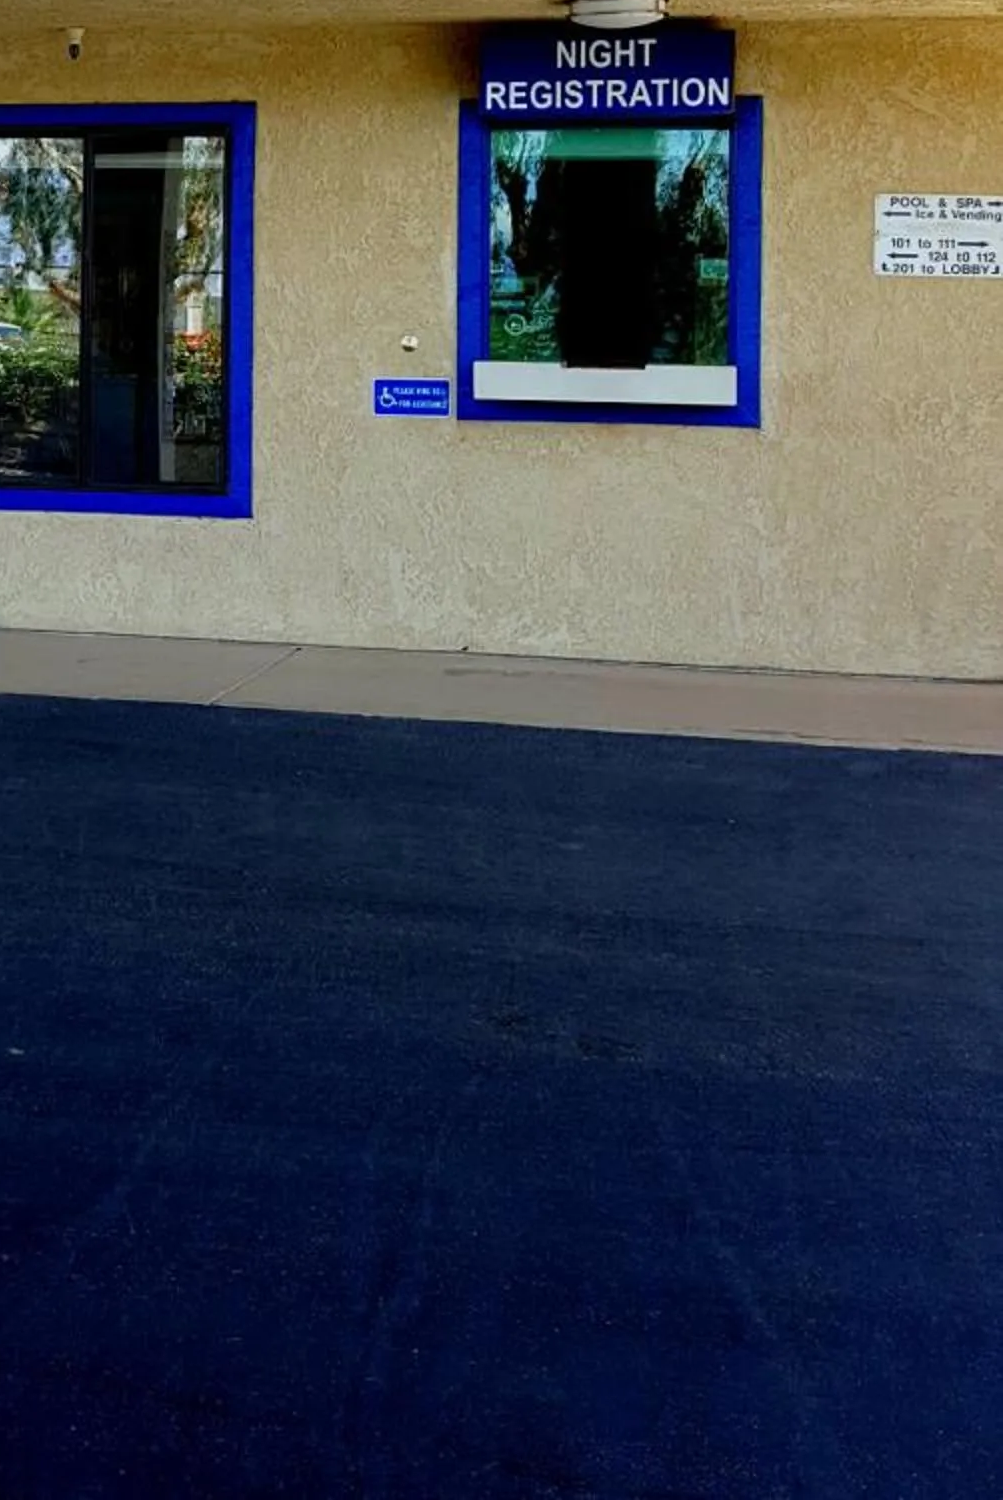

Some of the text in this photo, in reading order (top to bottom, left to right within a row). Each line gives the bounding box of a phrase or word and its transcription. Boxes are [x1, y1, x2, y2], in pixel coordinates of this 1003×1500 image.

[556, 38, 657, 69] NIGHT
[485, 77, 730, 110] REGISTRATION
[890, 197, 983, 208] POOL & SPA
[916, 210, 1002, 222] Ice & Vending
[891, 238, 956, 249] 101 to 111
[928, 252, 949, 262] 124
[977, 252, 996, 262] 112
[893, 264, 989, 274] 201 to LOBBY
